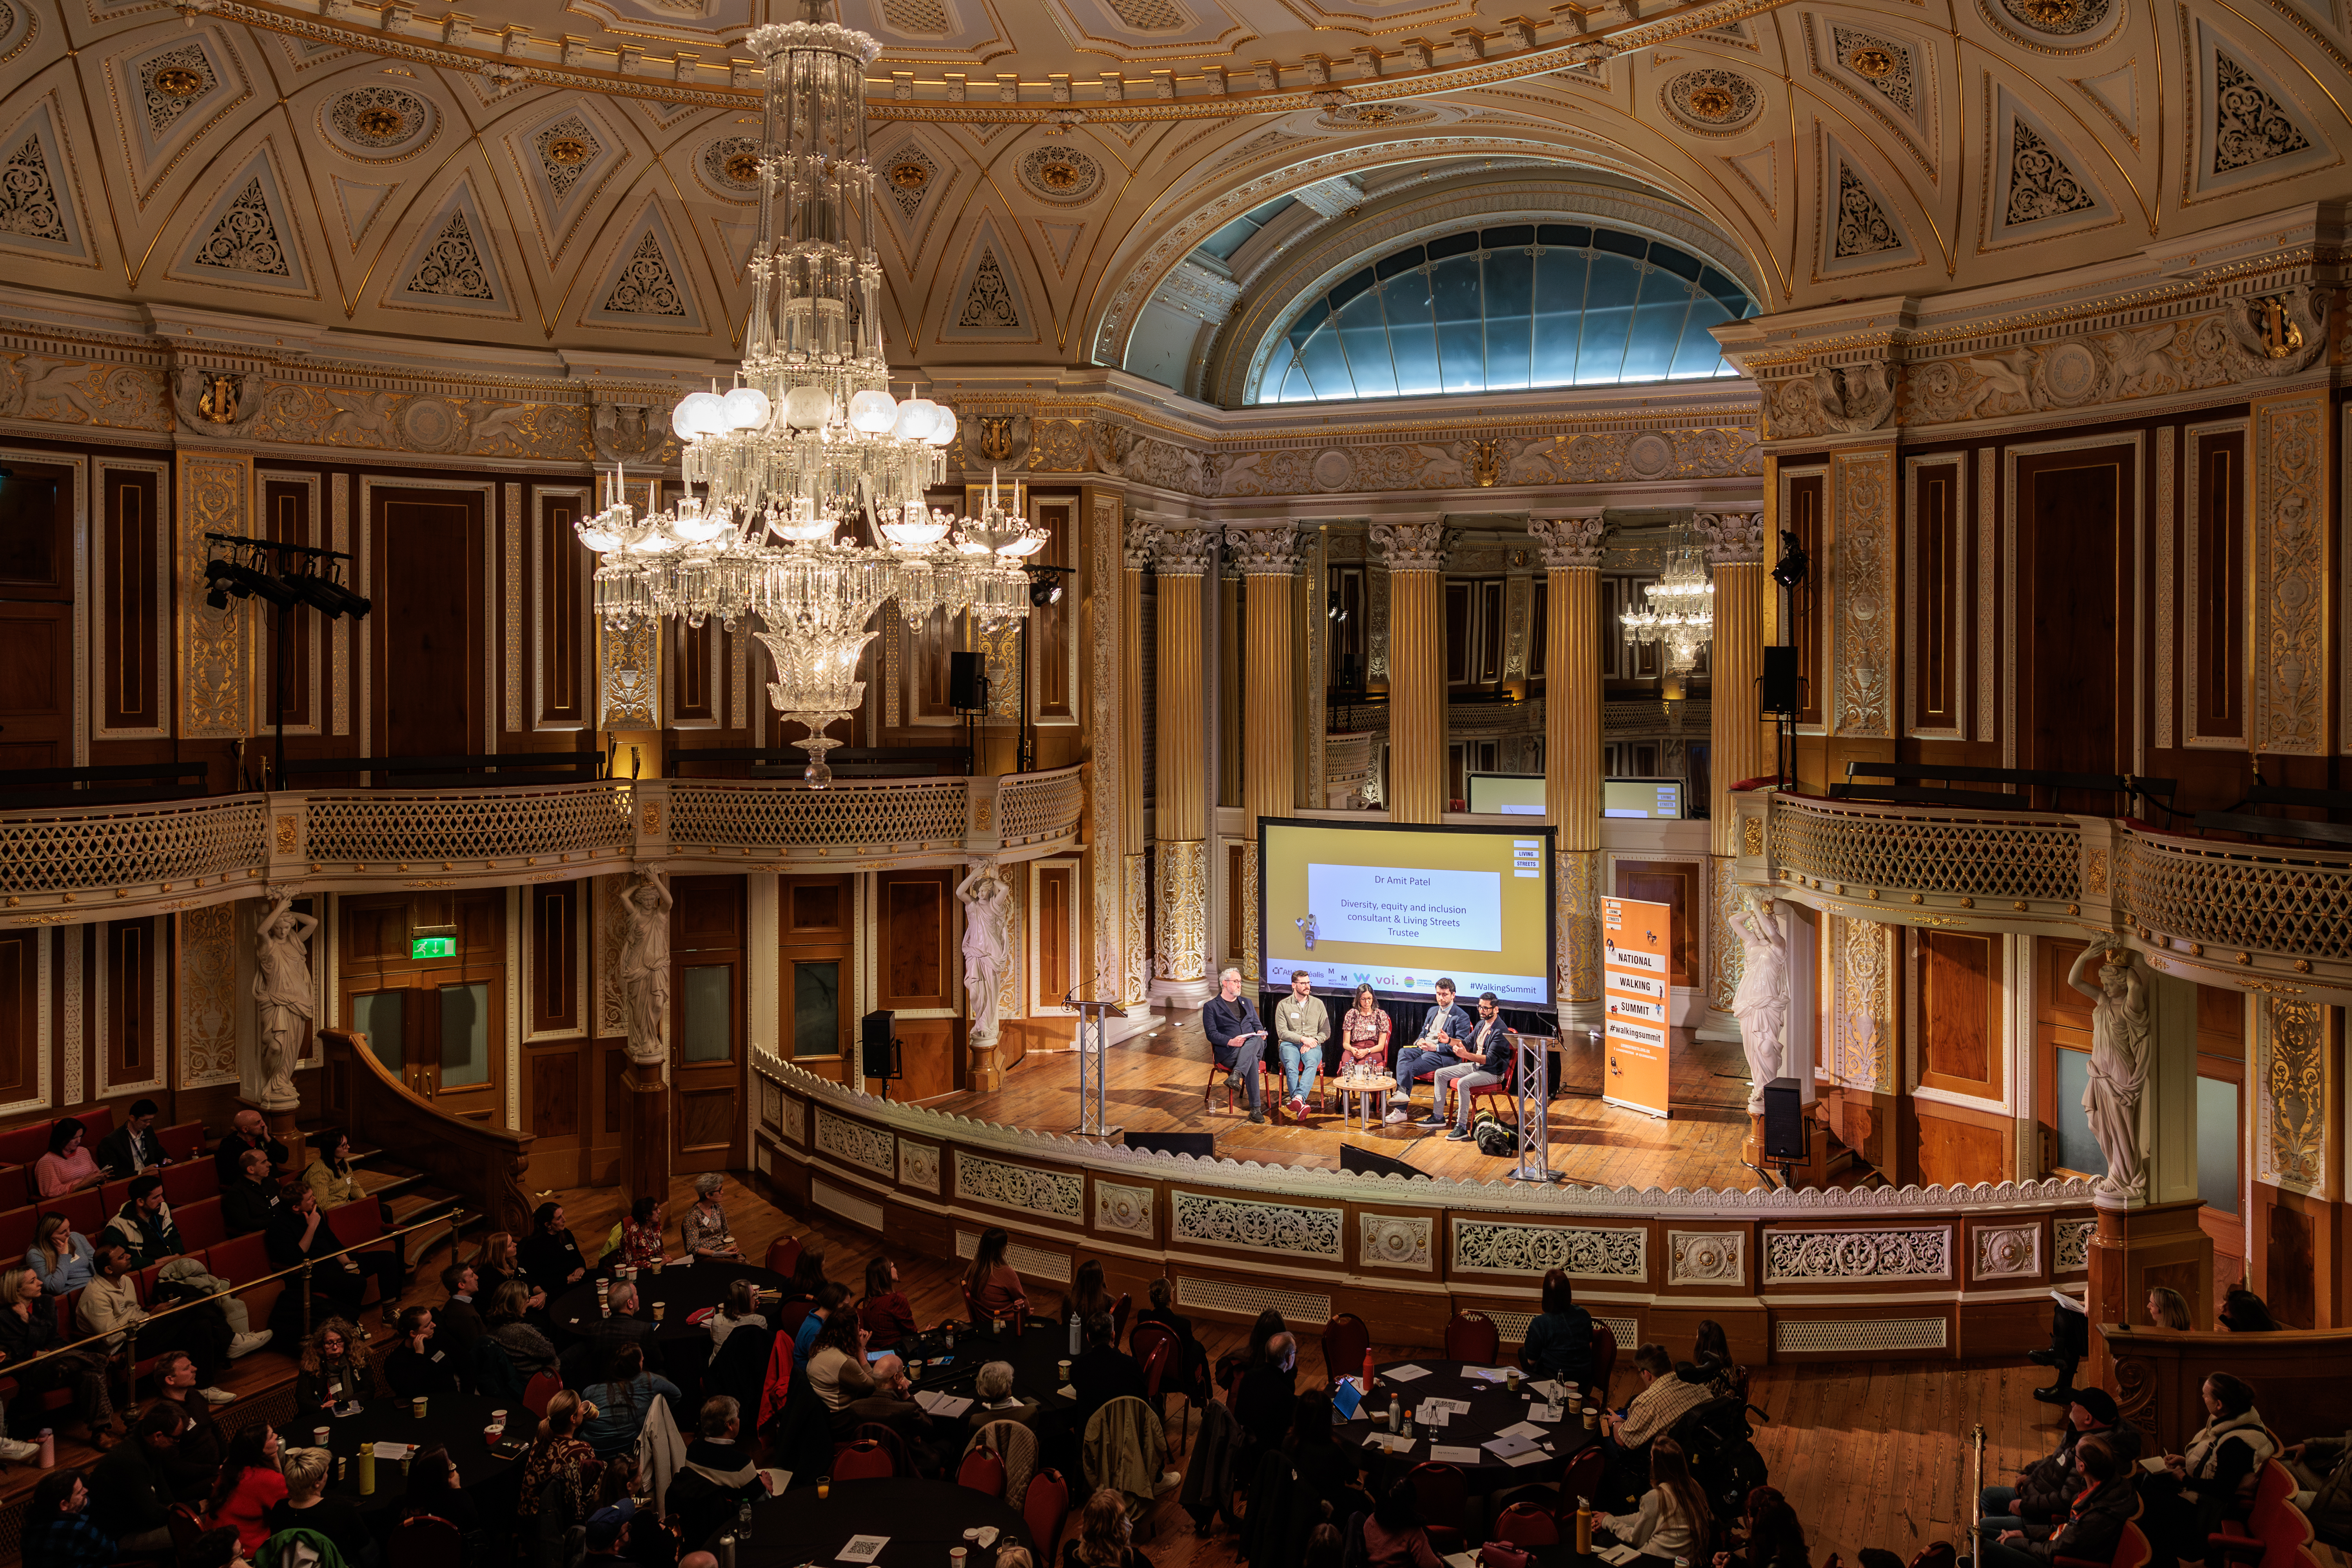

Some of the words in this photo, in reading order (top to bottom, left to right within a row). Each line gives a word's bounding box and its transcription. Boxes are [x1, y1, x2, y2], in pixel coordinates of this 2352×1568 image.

[1387, 876, 1407, 885] Amit
[1410, 877, 1430, 886] Patel
[1341, 899, 1379, 911] Diversity,
[1381, 902, 1408, 912] equity
[1428, 905, 1466, 914] inclusion
[1347, 914, 1391, 922] consultant
[1394, 915, 1401, 923] &
[1403, 916, 1428, 926] Living
[1430, 918, 1460, 927] Streets
[1388, 927, 1419, 937] Trustee
[1618, 953, 1651, 967] NATIONAL
[1375, 975, 1399, 985] voi.
[1620, 977, 1650, 991] WALKING
[1470, 982, 1537, 994] #WalkingSummit
[1621, 1002, 1649, 1015] SUMMIT
[1610, 1025, 1661, 1042] #walkingsummit
[1621, 1043, 1650, 1054] LIVINGSTREETS.ORG.UK
